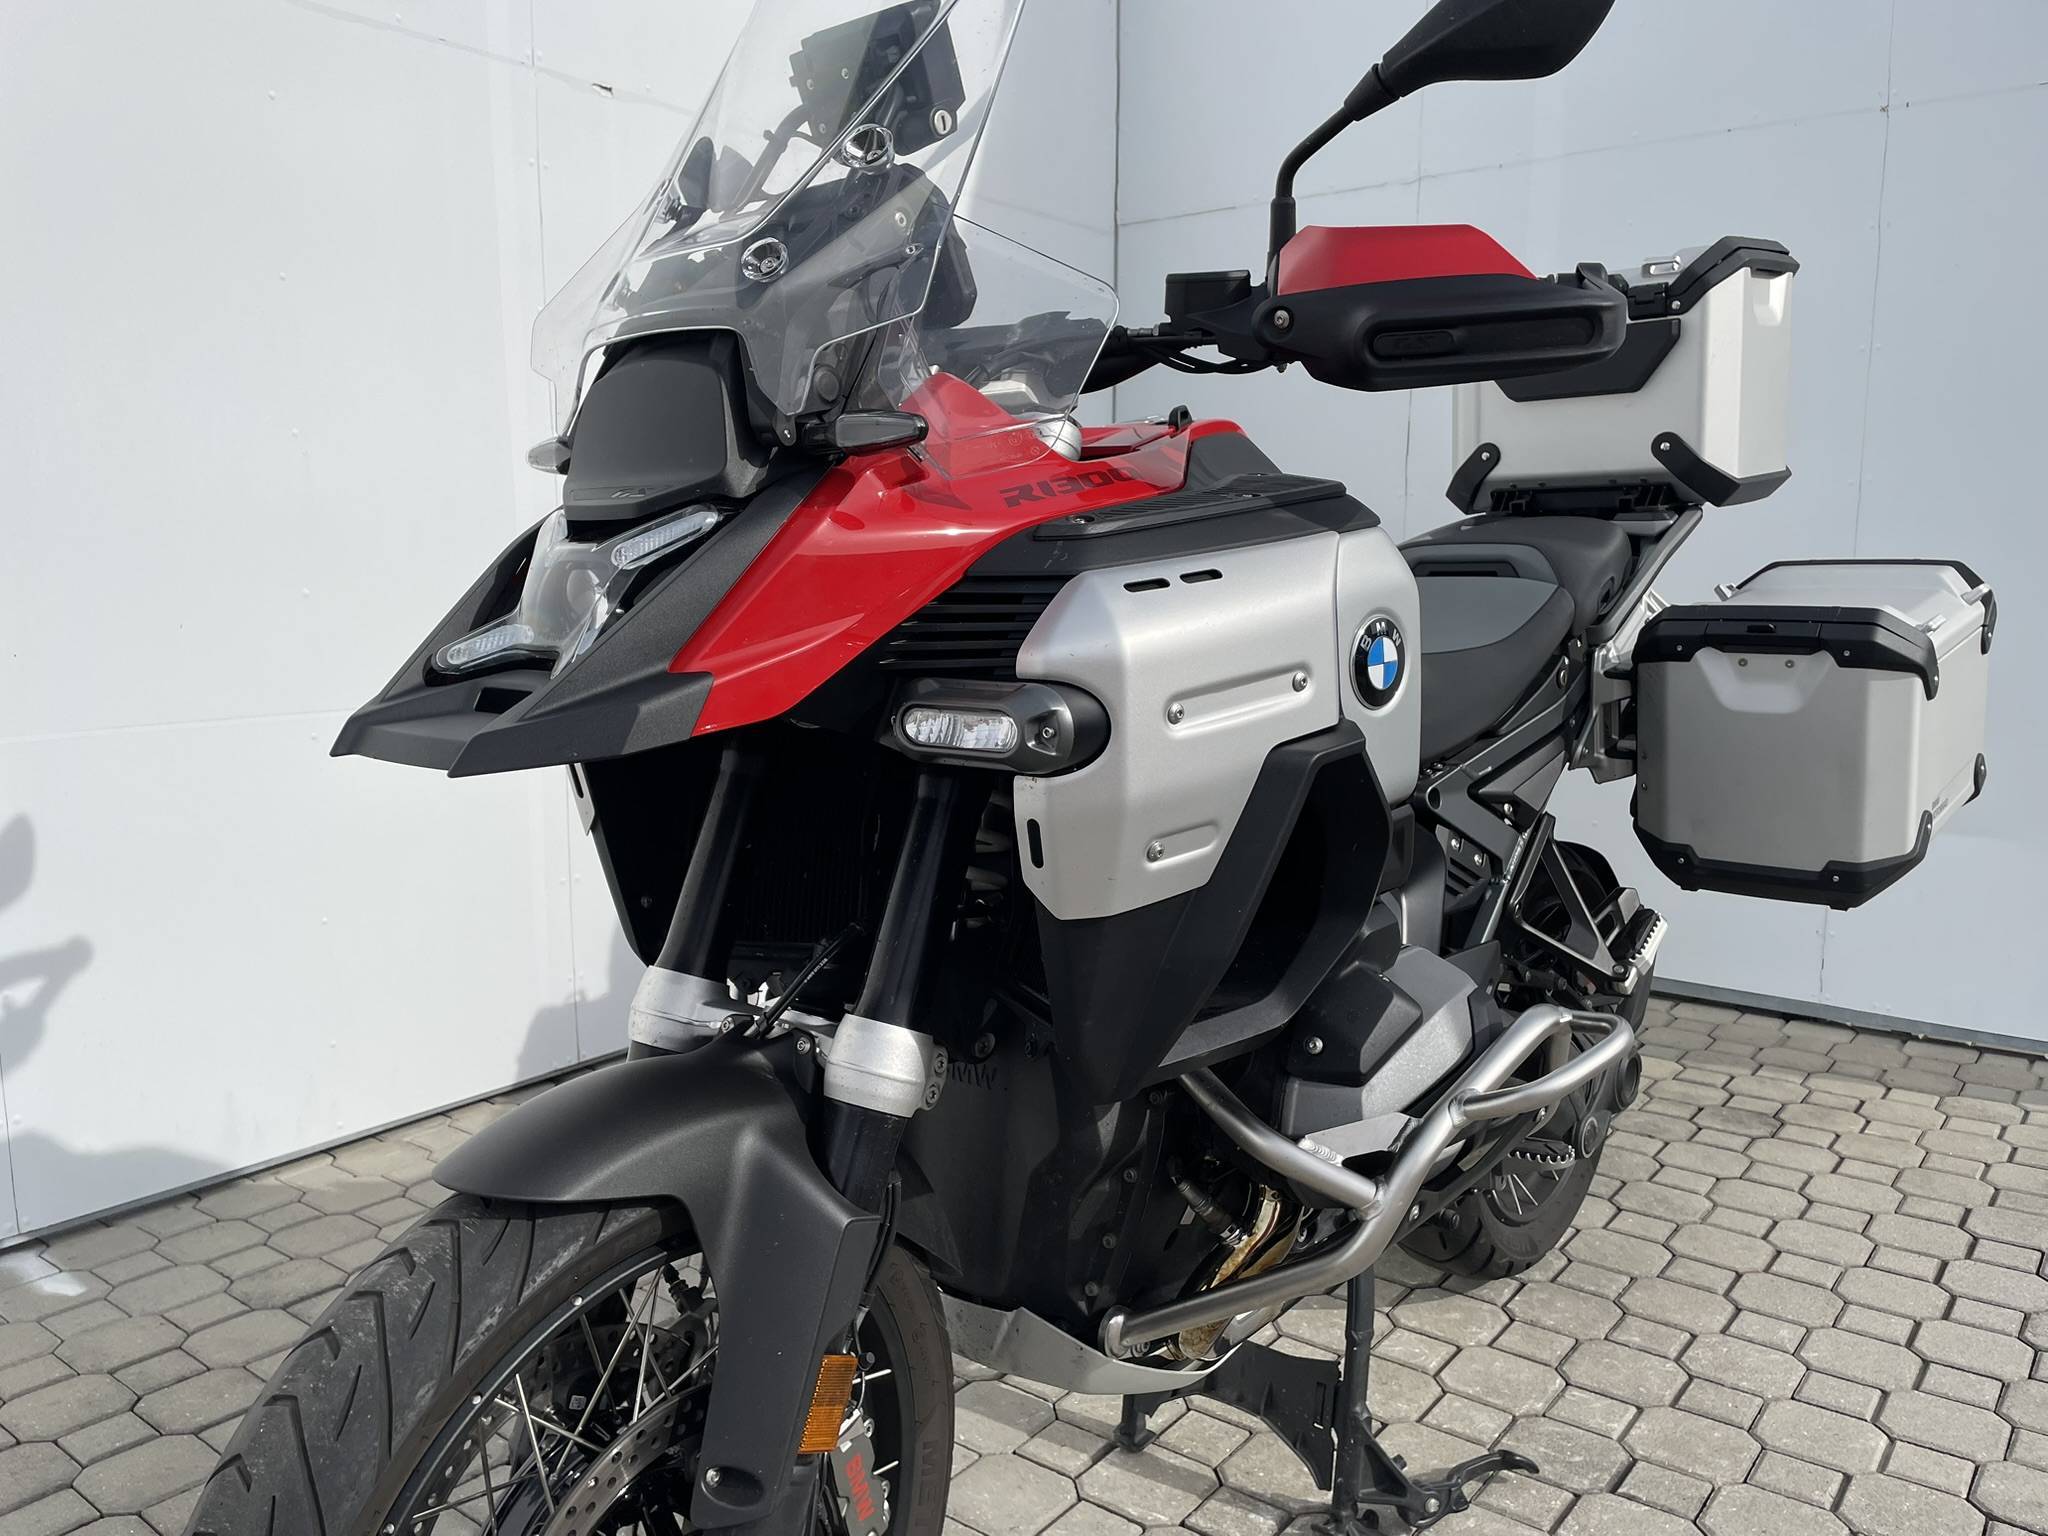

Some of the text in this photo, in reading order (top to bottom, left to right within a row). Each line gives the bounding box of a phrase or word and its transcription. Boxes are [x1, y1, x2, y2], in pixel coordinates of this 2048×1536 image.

[1360, 621, 1402, 651] BMW
[946, 1062, 998, 1090] MW
[846, 1453, 876, 1521] BMW
